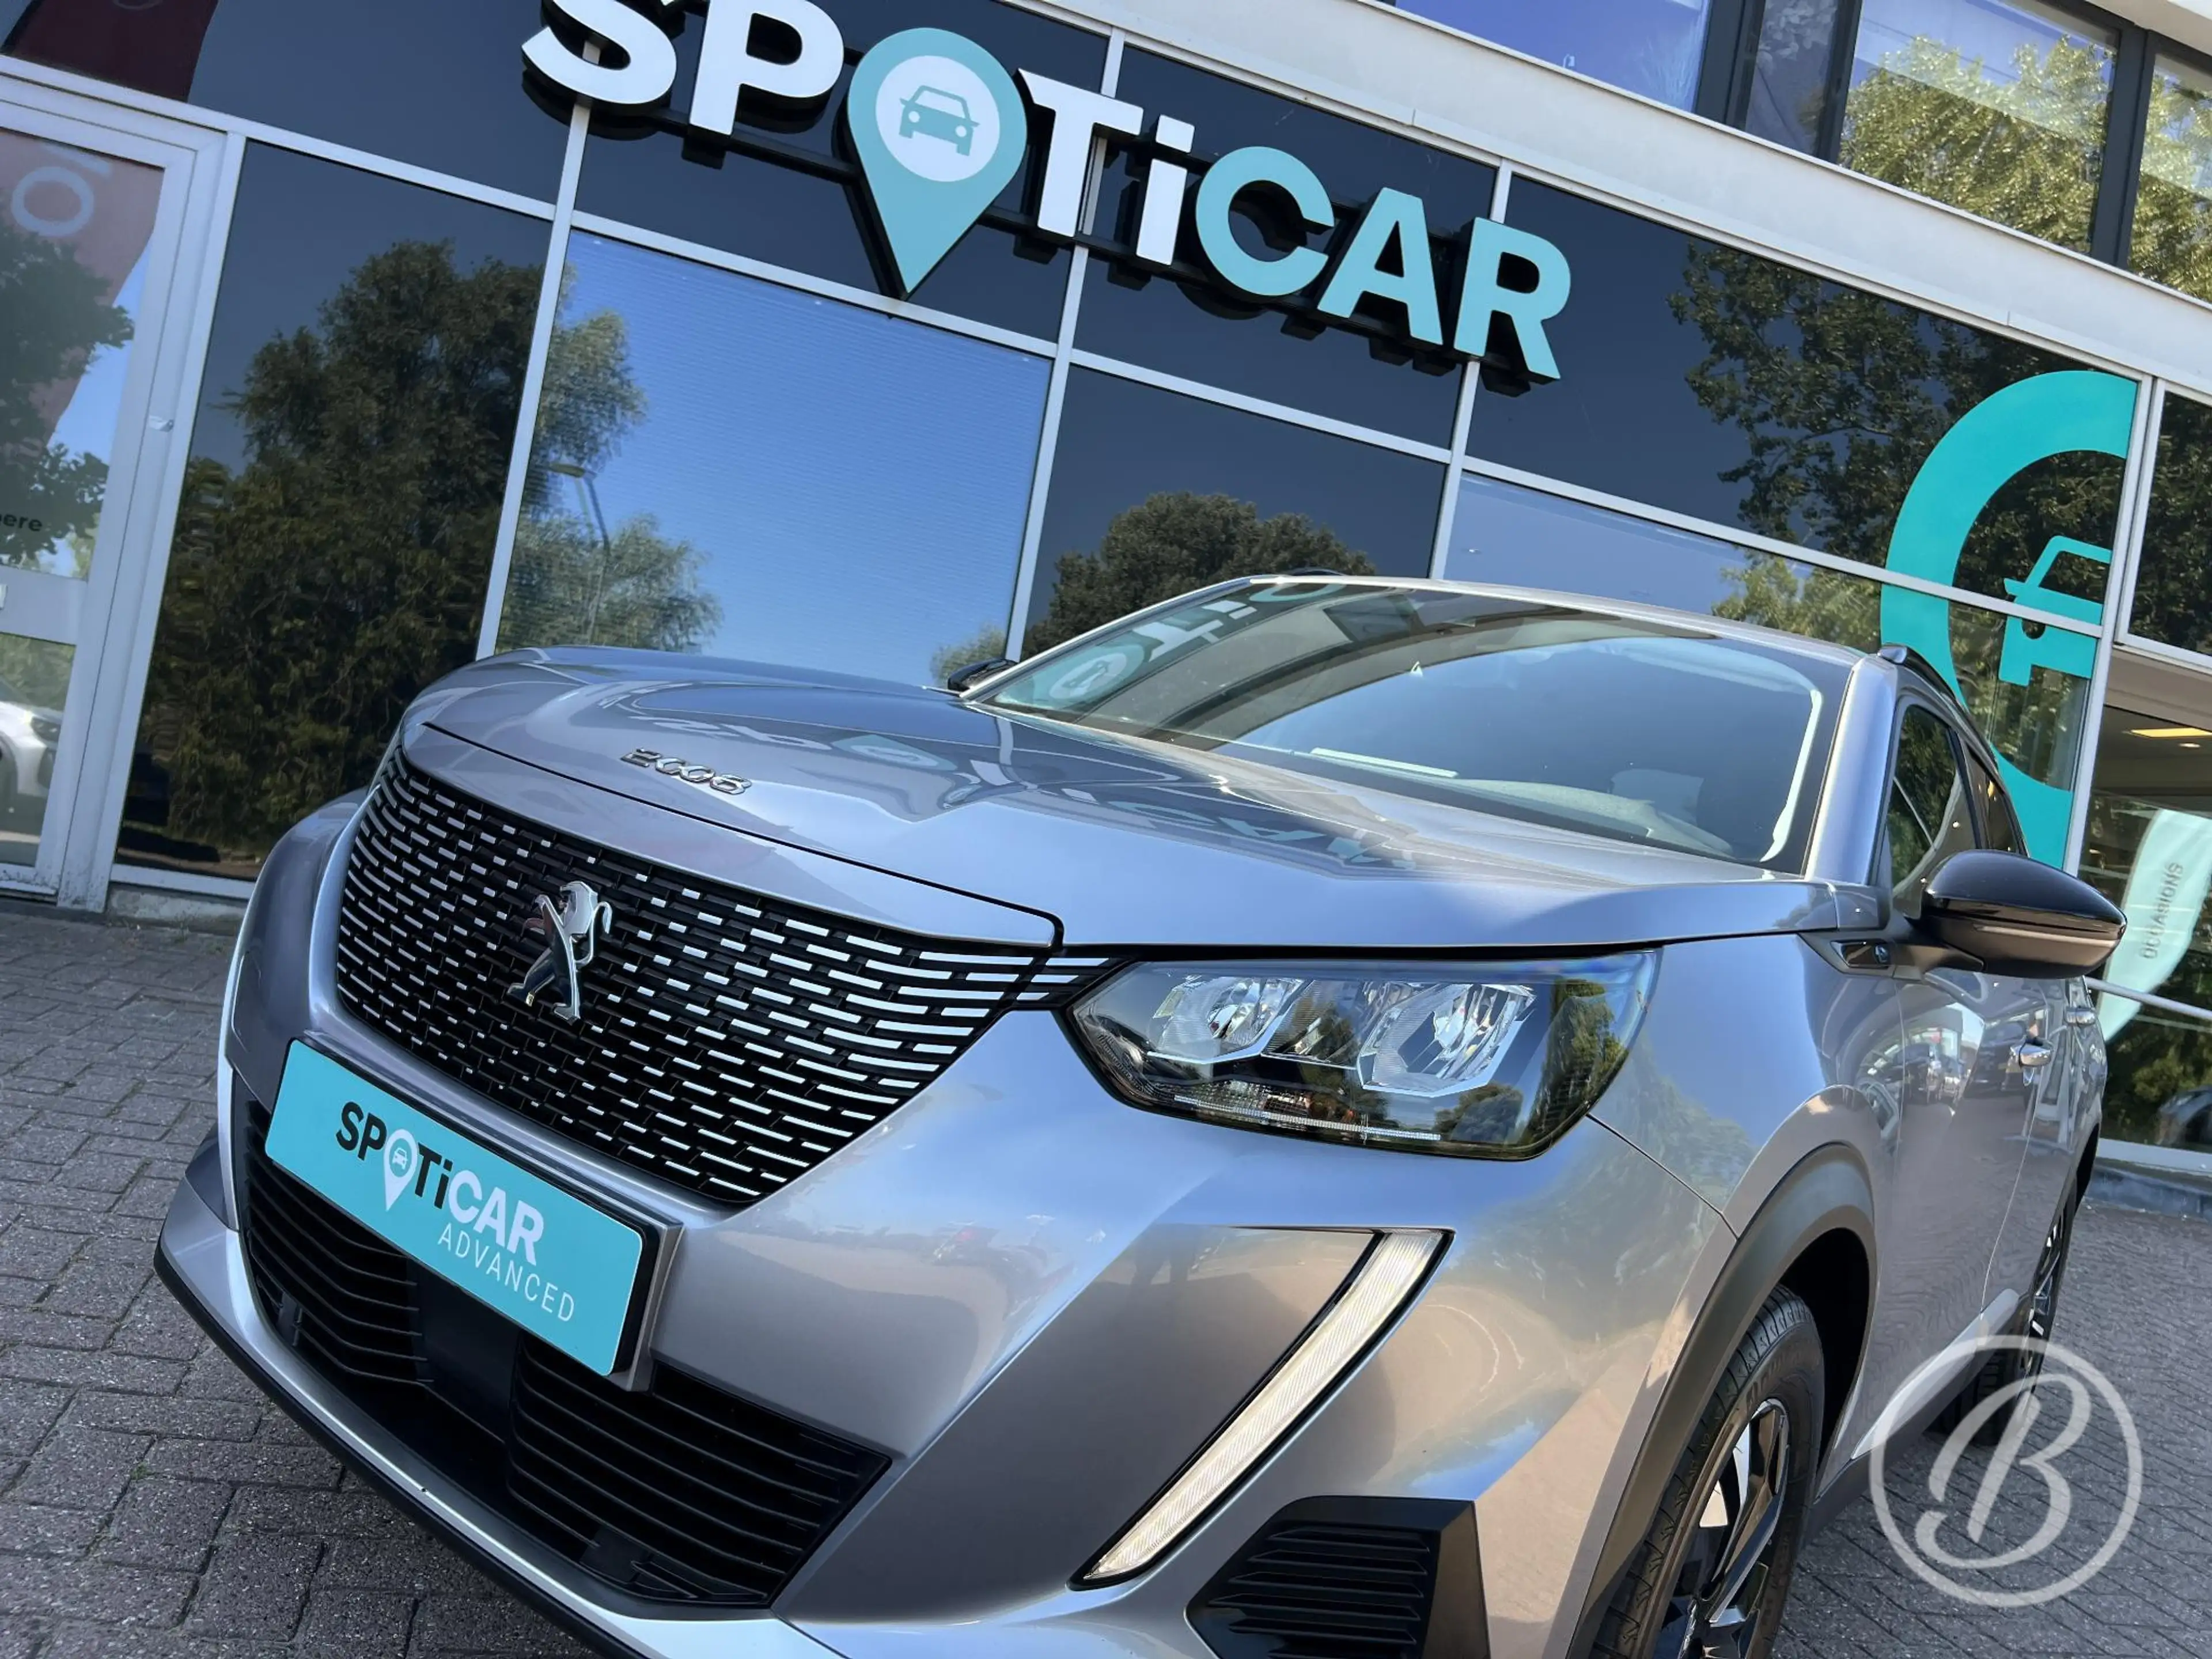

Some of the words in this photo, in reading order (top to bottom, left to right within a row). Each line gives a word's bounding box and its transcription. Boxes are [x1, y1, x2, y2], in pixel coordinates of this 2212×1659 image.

[0, 513, 43, 532] ere
[2139, 862, 2184, 959] OCCASIONS
[437, 1224, 575, 1321] ADVANCED
